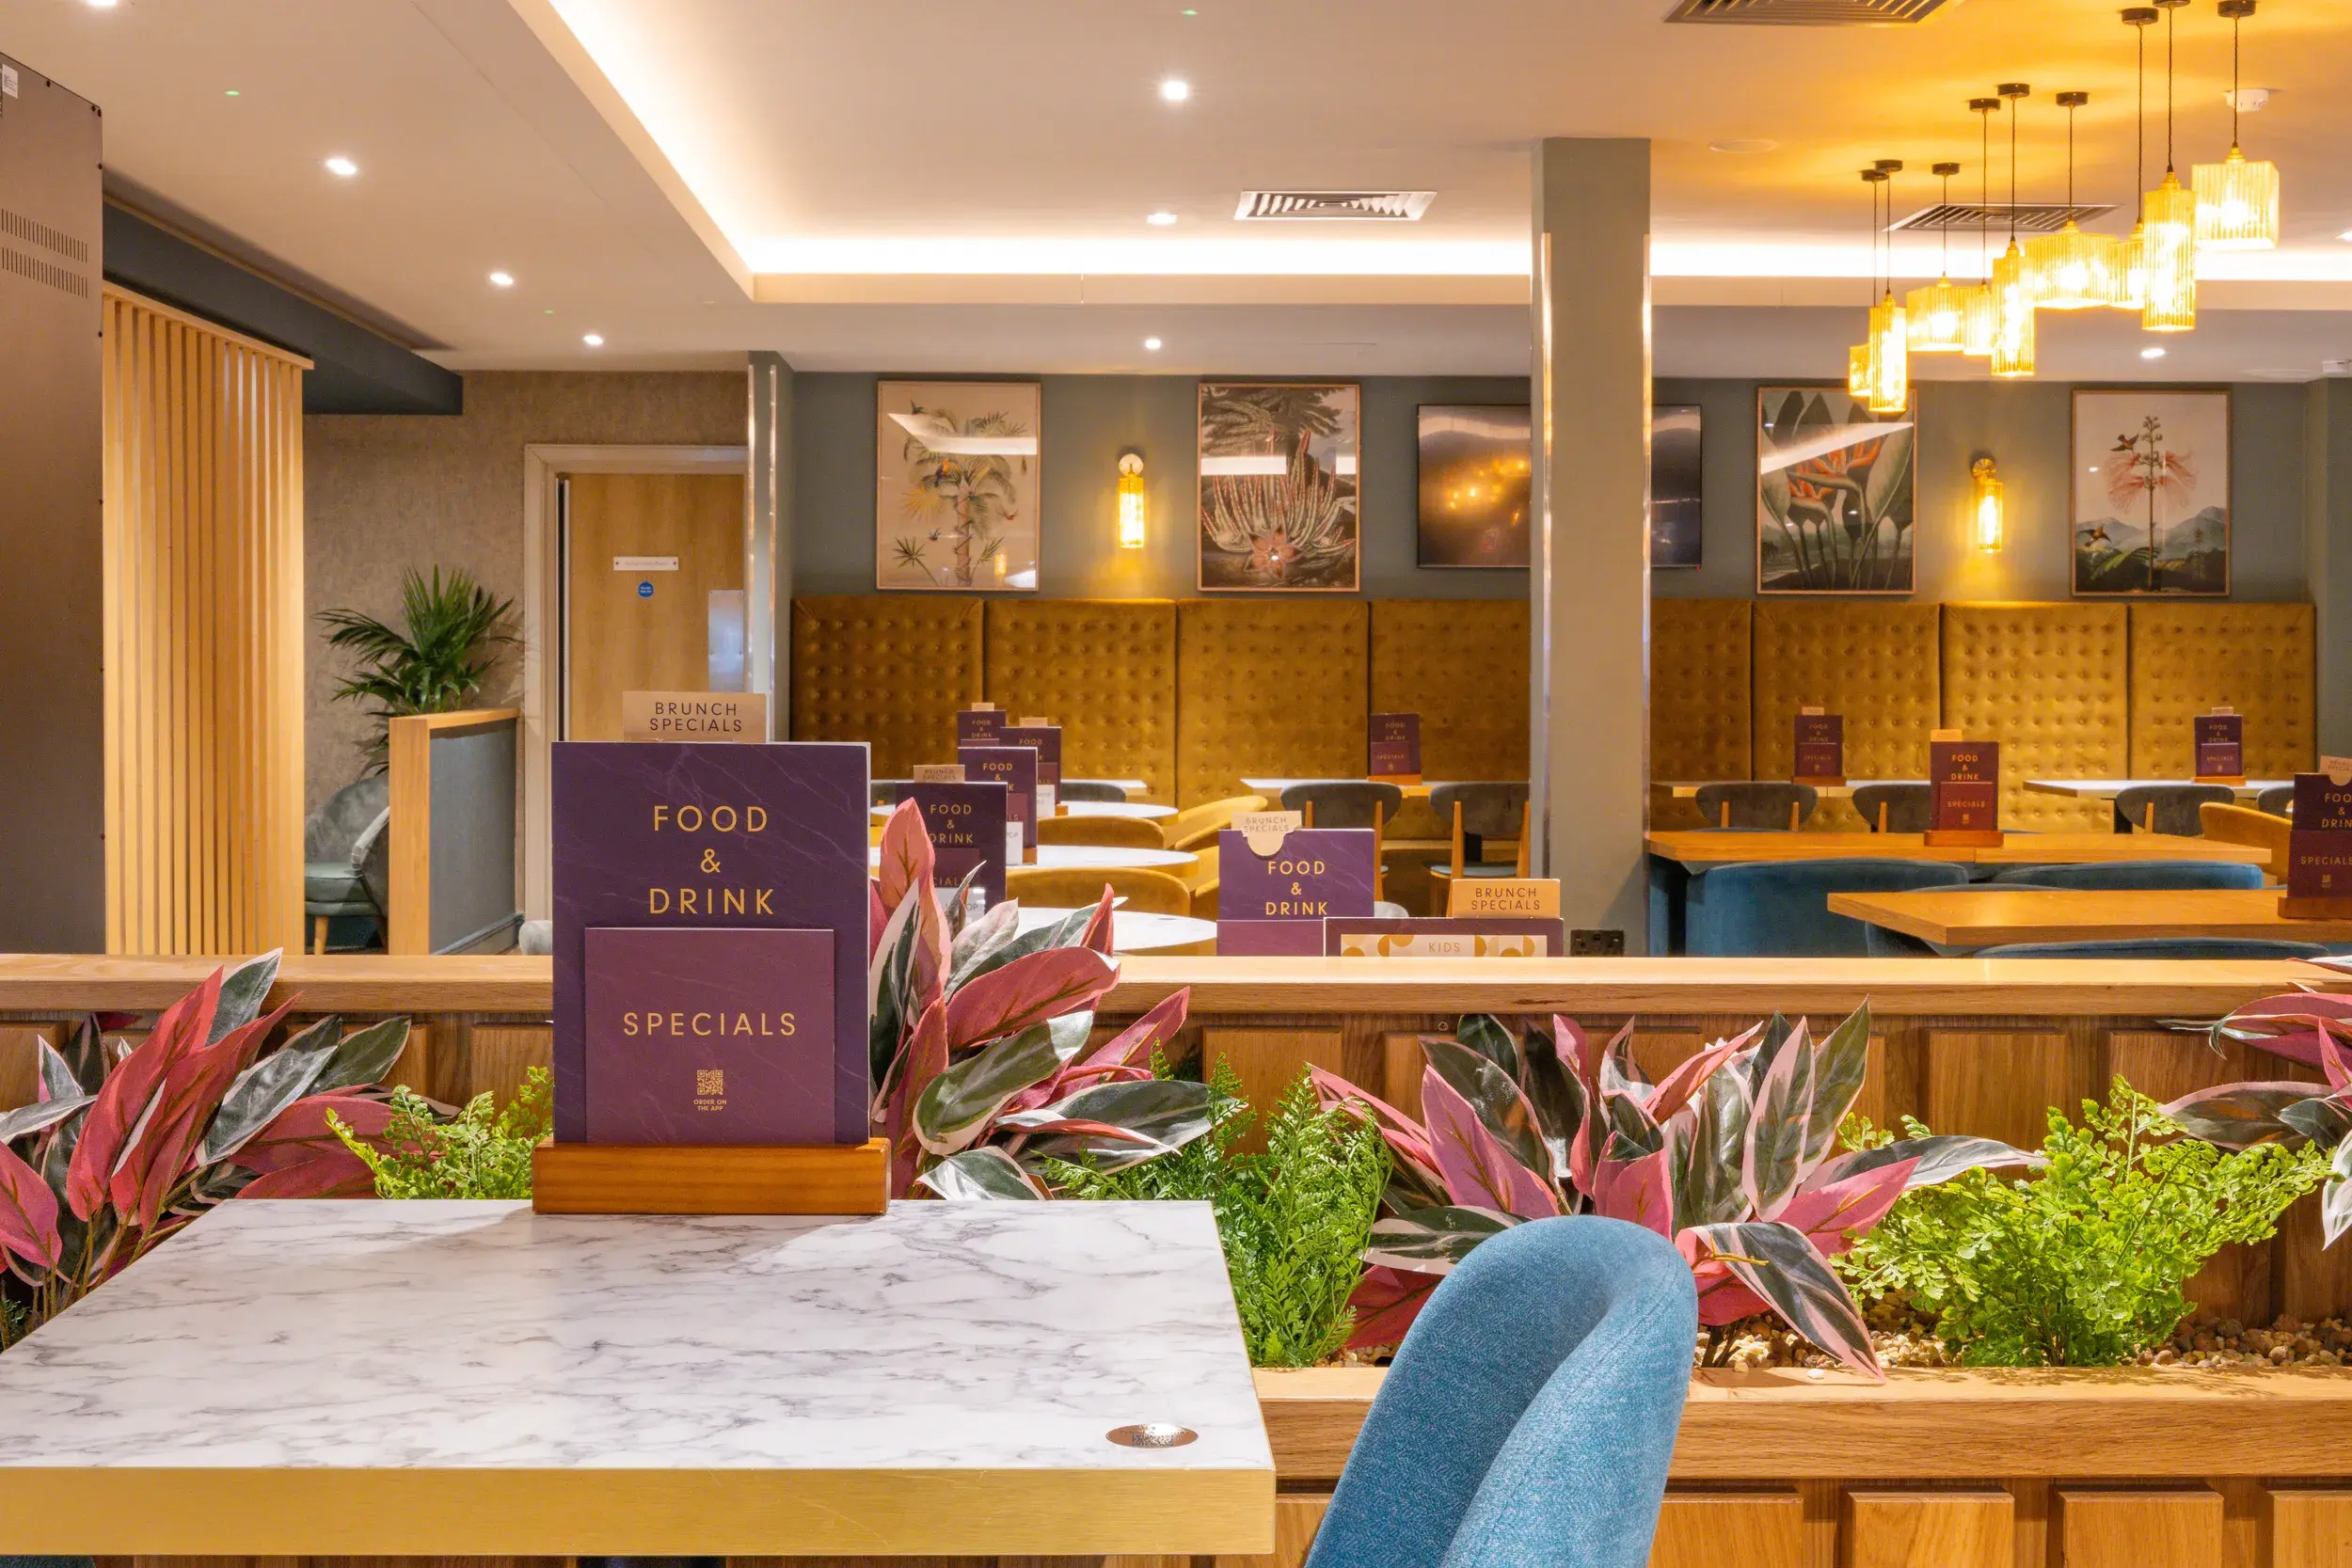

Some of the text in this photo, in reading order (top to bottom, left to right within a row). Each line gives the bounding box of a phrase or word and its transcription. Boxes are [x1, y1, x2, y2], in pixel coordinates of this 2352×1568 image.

[655, 702, 737, 716] BRUNCH
[649, 718, 742, 733] SPECIALS
[1951, 753, 1979, 762] FOOD
[982, 763, 1013, 771] FOOD
[2325, 793, 2352, 803] FOO
[930, 804, 972, 815] FOOD
[2338, 806, 2345, 816] &
[654, 805, 768, 832] FOOD
[1246, 816, 1287, 825] BRUNCH
[2321, 818, 2352, 828] DRIN
[946, 819, 955, 830] &
[1243, 824, 1289, 833] SPECIALS
[929, 833, 973, 844] DRINK
[700, 848, 722, 874] &
[1267, 861, 1326, 875] FOOD
[1291, 881, 1302, 895] &
[1475, 887, 1536, 898] BRUNCH
[649, 888, 774, 914] DRINK
[1470, 899, 1540, 911] SPECIALS
[1265, 901, 1327, 915] DRINK
[623, 1012, 796, 1037] SPECIALS
